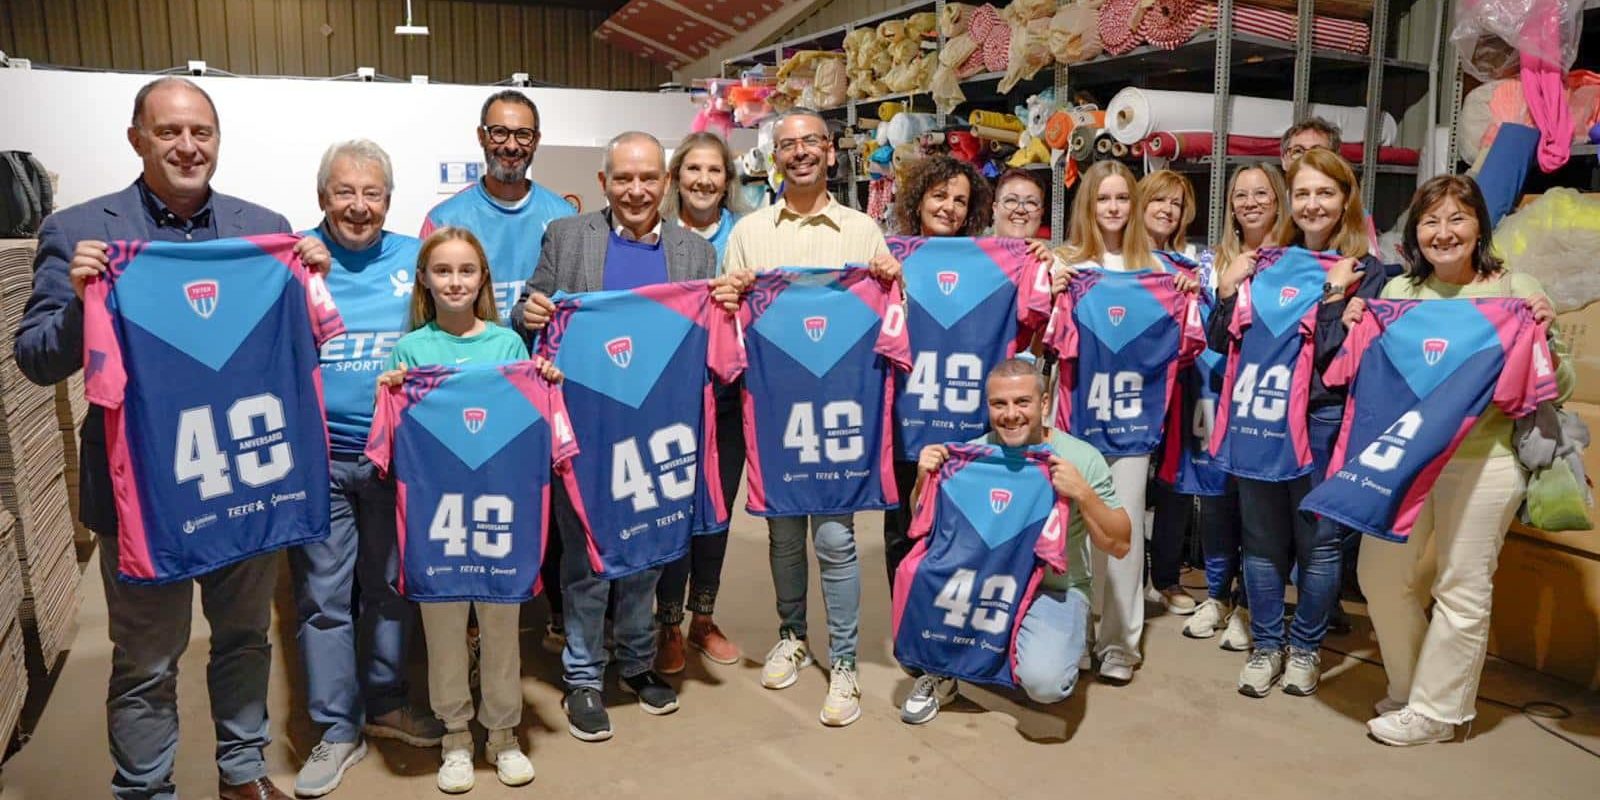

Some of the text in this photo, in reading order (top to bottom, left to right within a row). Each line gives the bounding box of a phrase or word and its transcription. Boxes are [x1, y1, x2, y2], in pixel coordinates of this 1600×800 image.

[308, 273, 337, 312] 4
[882, 304, 905, 337] 0
[320, 331, 400, 360] ETE
[906, 352, 983, 413] 40
[1087, 371, 1144, 421] 40
[1232, 363, 1291, 422] 40
[174, 393, 295, 500] 40
[239, 431, 283, 450] ANIVERSARIO
[783, 400, 865, 464] 40
[611, 422, 697, 513] 40
[429, 493, 514, 559] 40
[933, 568, 1018, 636] 40
